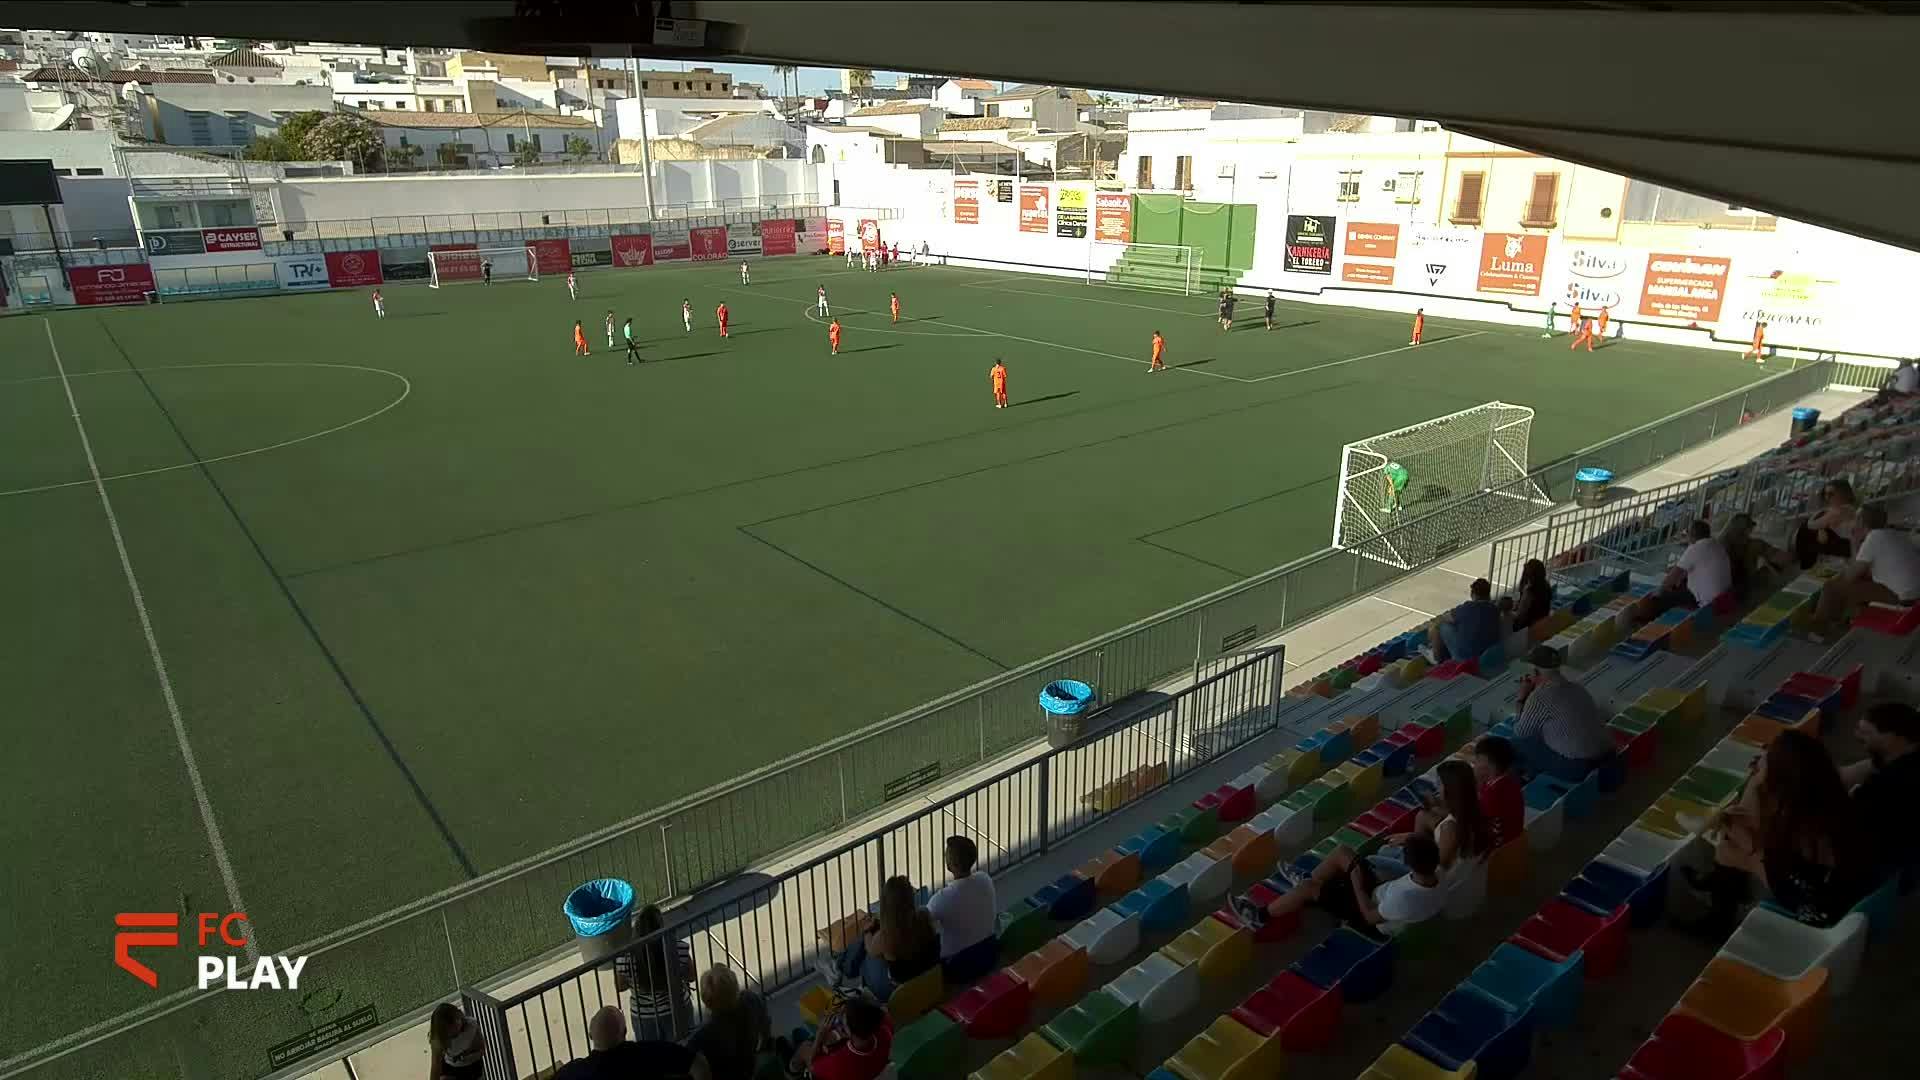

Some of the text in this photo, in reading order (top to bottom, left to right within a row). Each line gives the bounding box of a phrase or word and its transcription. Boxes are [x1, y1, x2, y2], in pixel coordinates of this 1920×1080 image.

[219, 232, 258, 243] CAYSER
[1490, 256, 1535, 273] Luma
[274, 1053, 285, 1062] NO
[343, 1023, 352, 1032] AL
[352, 1014, 373, 1028] SUELO
